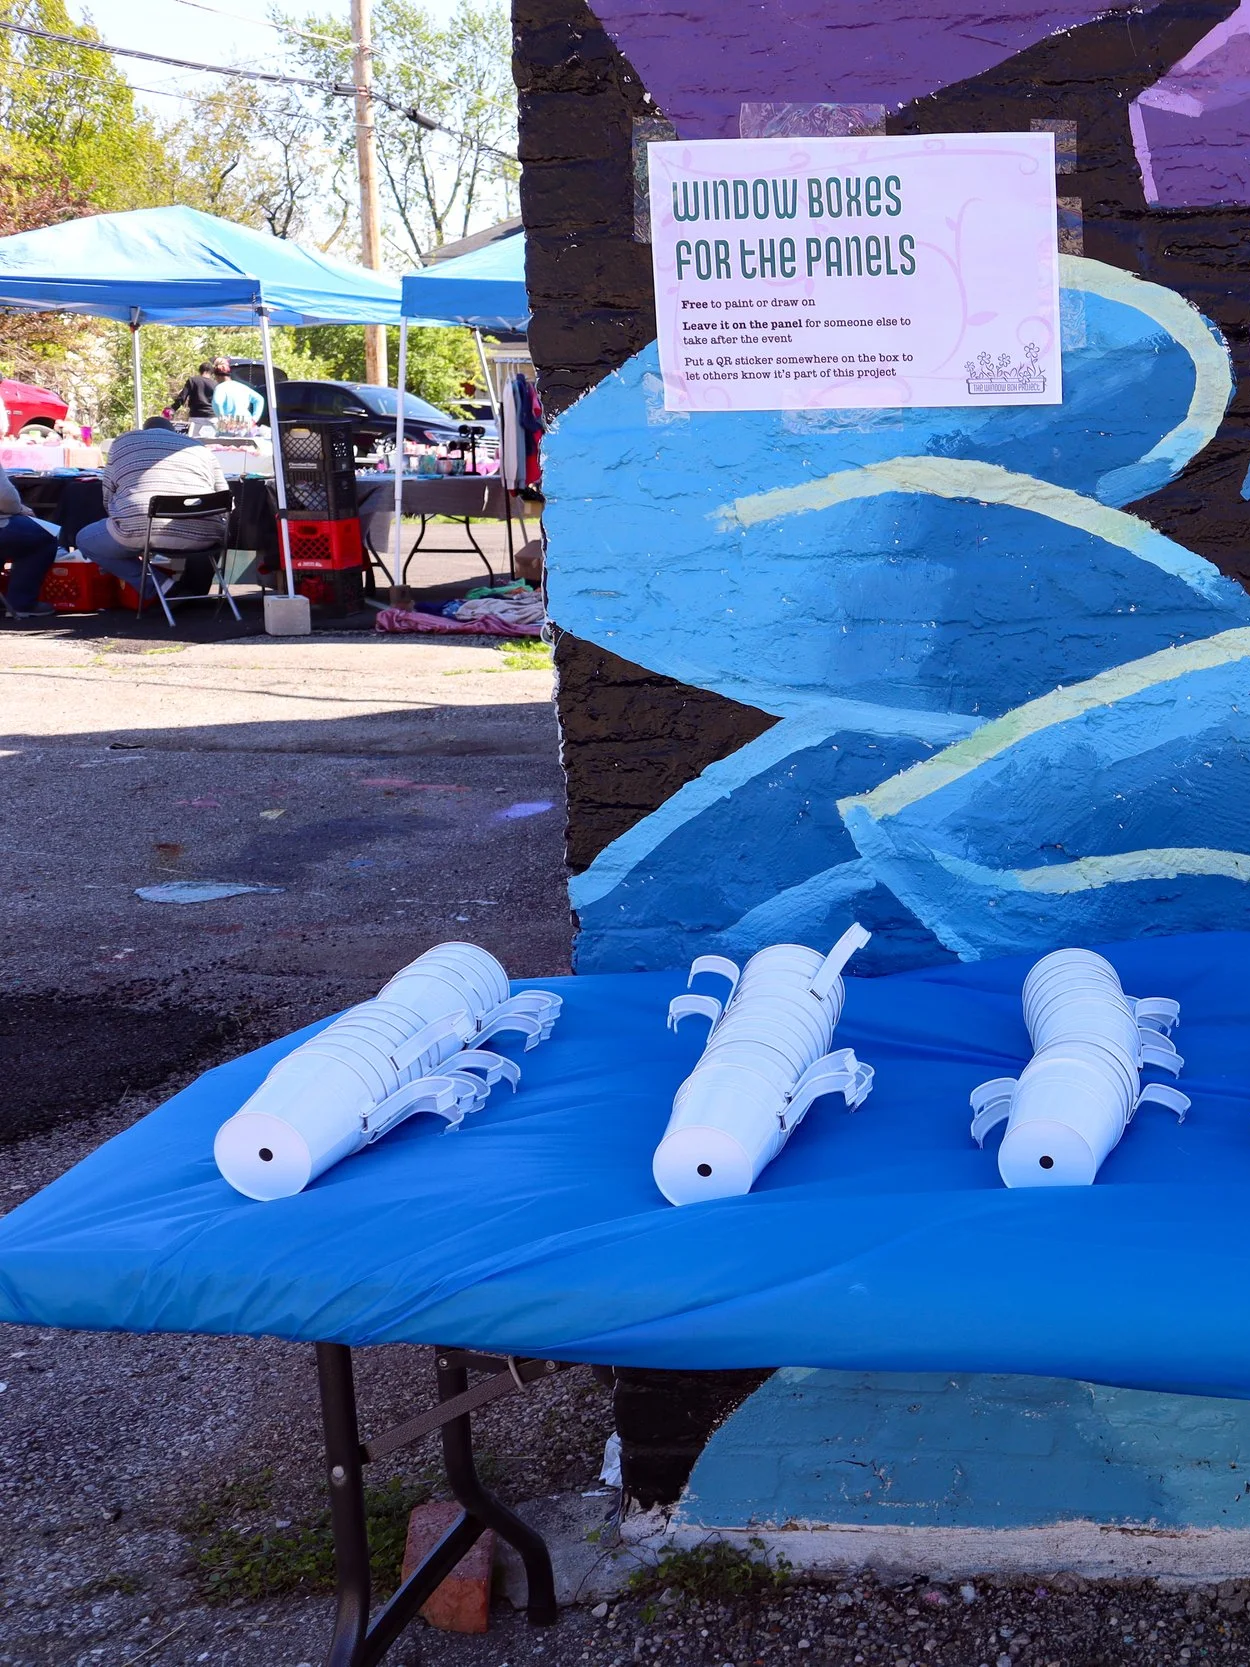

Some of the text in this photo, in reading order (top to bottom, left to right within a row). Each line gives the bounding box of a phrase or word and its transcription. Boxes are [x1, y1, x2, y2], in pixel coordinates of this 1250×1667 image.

[672, 176, 901, 221] WINDOW BOXES
[676, 235, 915, 280] FOR THE PANELS
[681, 300, 708, 309] Free
[711, 300, 721, 308] to
[725, 299, 754, 310] paint
[771, 298, 799, 307] draw
[683, 322, 717, 330] Leave
[719, 321, 729, 329] it
[748, 320, 768, 329] the
[771, 319, 802, 330] panel
[805, 319, 821, 327] for
[875, 317, 897, 326] else
[900, 317, 911, 325] to
[683, 334, 792, 345] take after the event
[685, 358, 704, 366] Put
[716, 357, 732, 367] QR
[735, 355, 772, 366] sticker
[774, 354, 839, 364] somewhere
[858, 354, 876, 362] the
[880, 353, 899, 362] box
[902, 353, 913, 361] to
[686, 368, 896, 380] let others know it's part of this project
